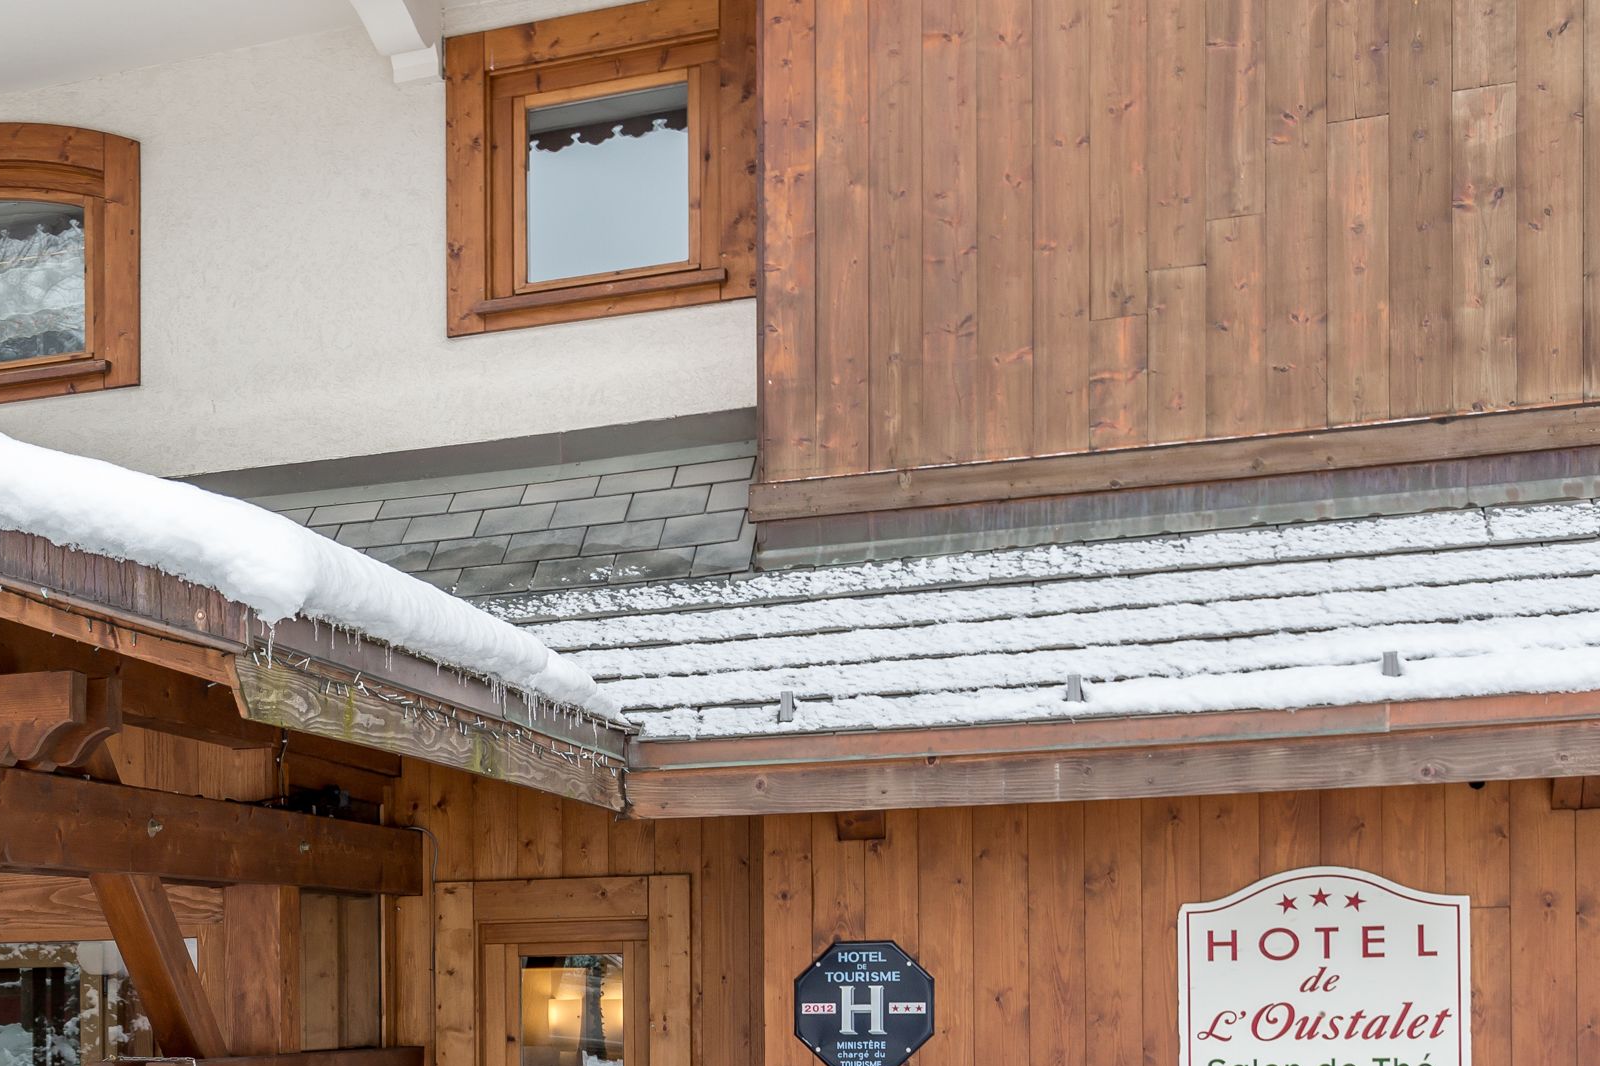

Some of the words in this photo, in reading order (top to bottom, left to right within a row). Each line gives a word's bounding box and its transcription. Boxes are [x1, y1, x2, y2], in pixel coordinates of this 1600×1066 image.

[1206, 924, 1438, 962] HOTEL
[837, 951, 887, 963] HOTEL
[824, 971, 901, 983] TOURISME
[1299, 966, 1340, 993] de
[804, 1004, 834, 1013] 2012
[838, 985, 888, 1035] H
[1196, 1001, 1453, 1042] L'Oustalet
[836, 1040, 886, 1050] MINISTÈRE
[837, 1050, 869, 1060] chargé
[874, 1050, 886, 1058] du
